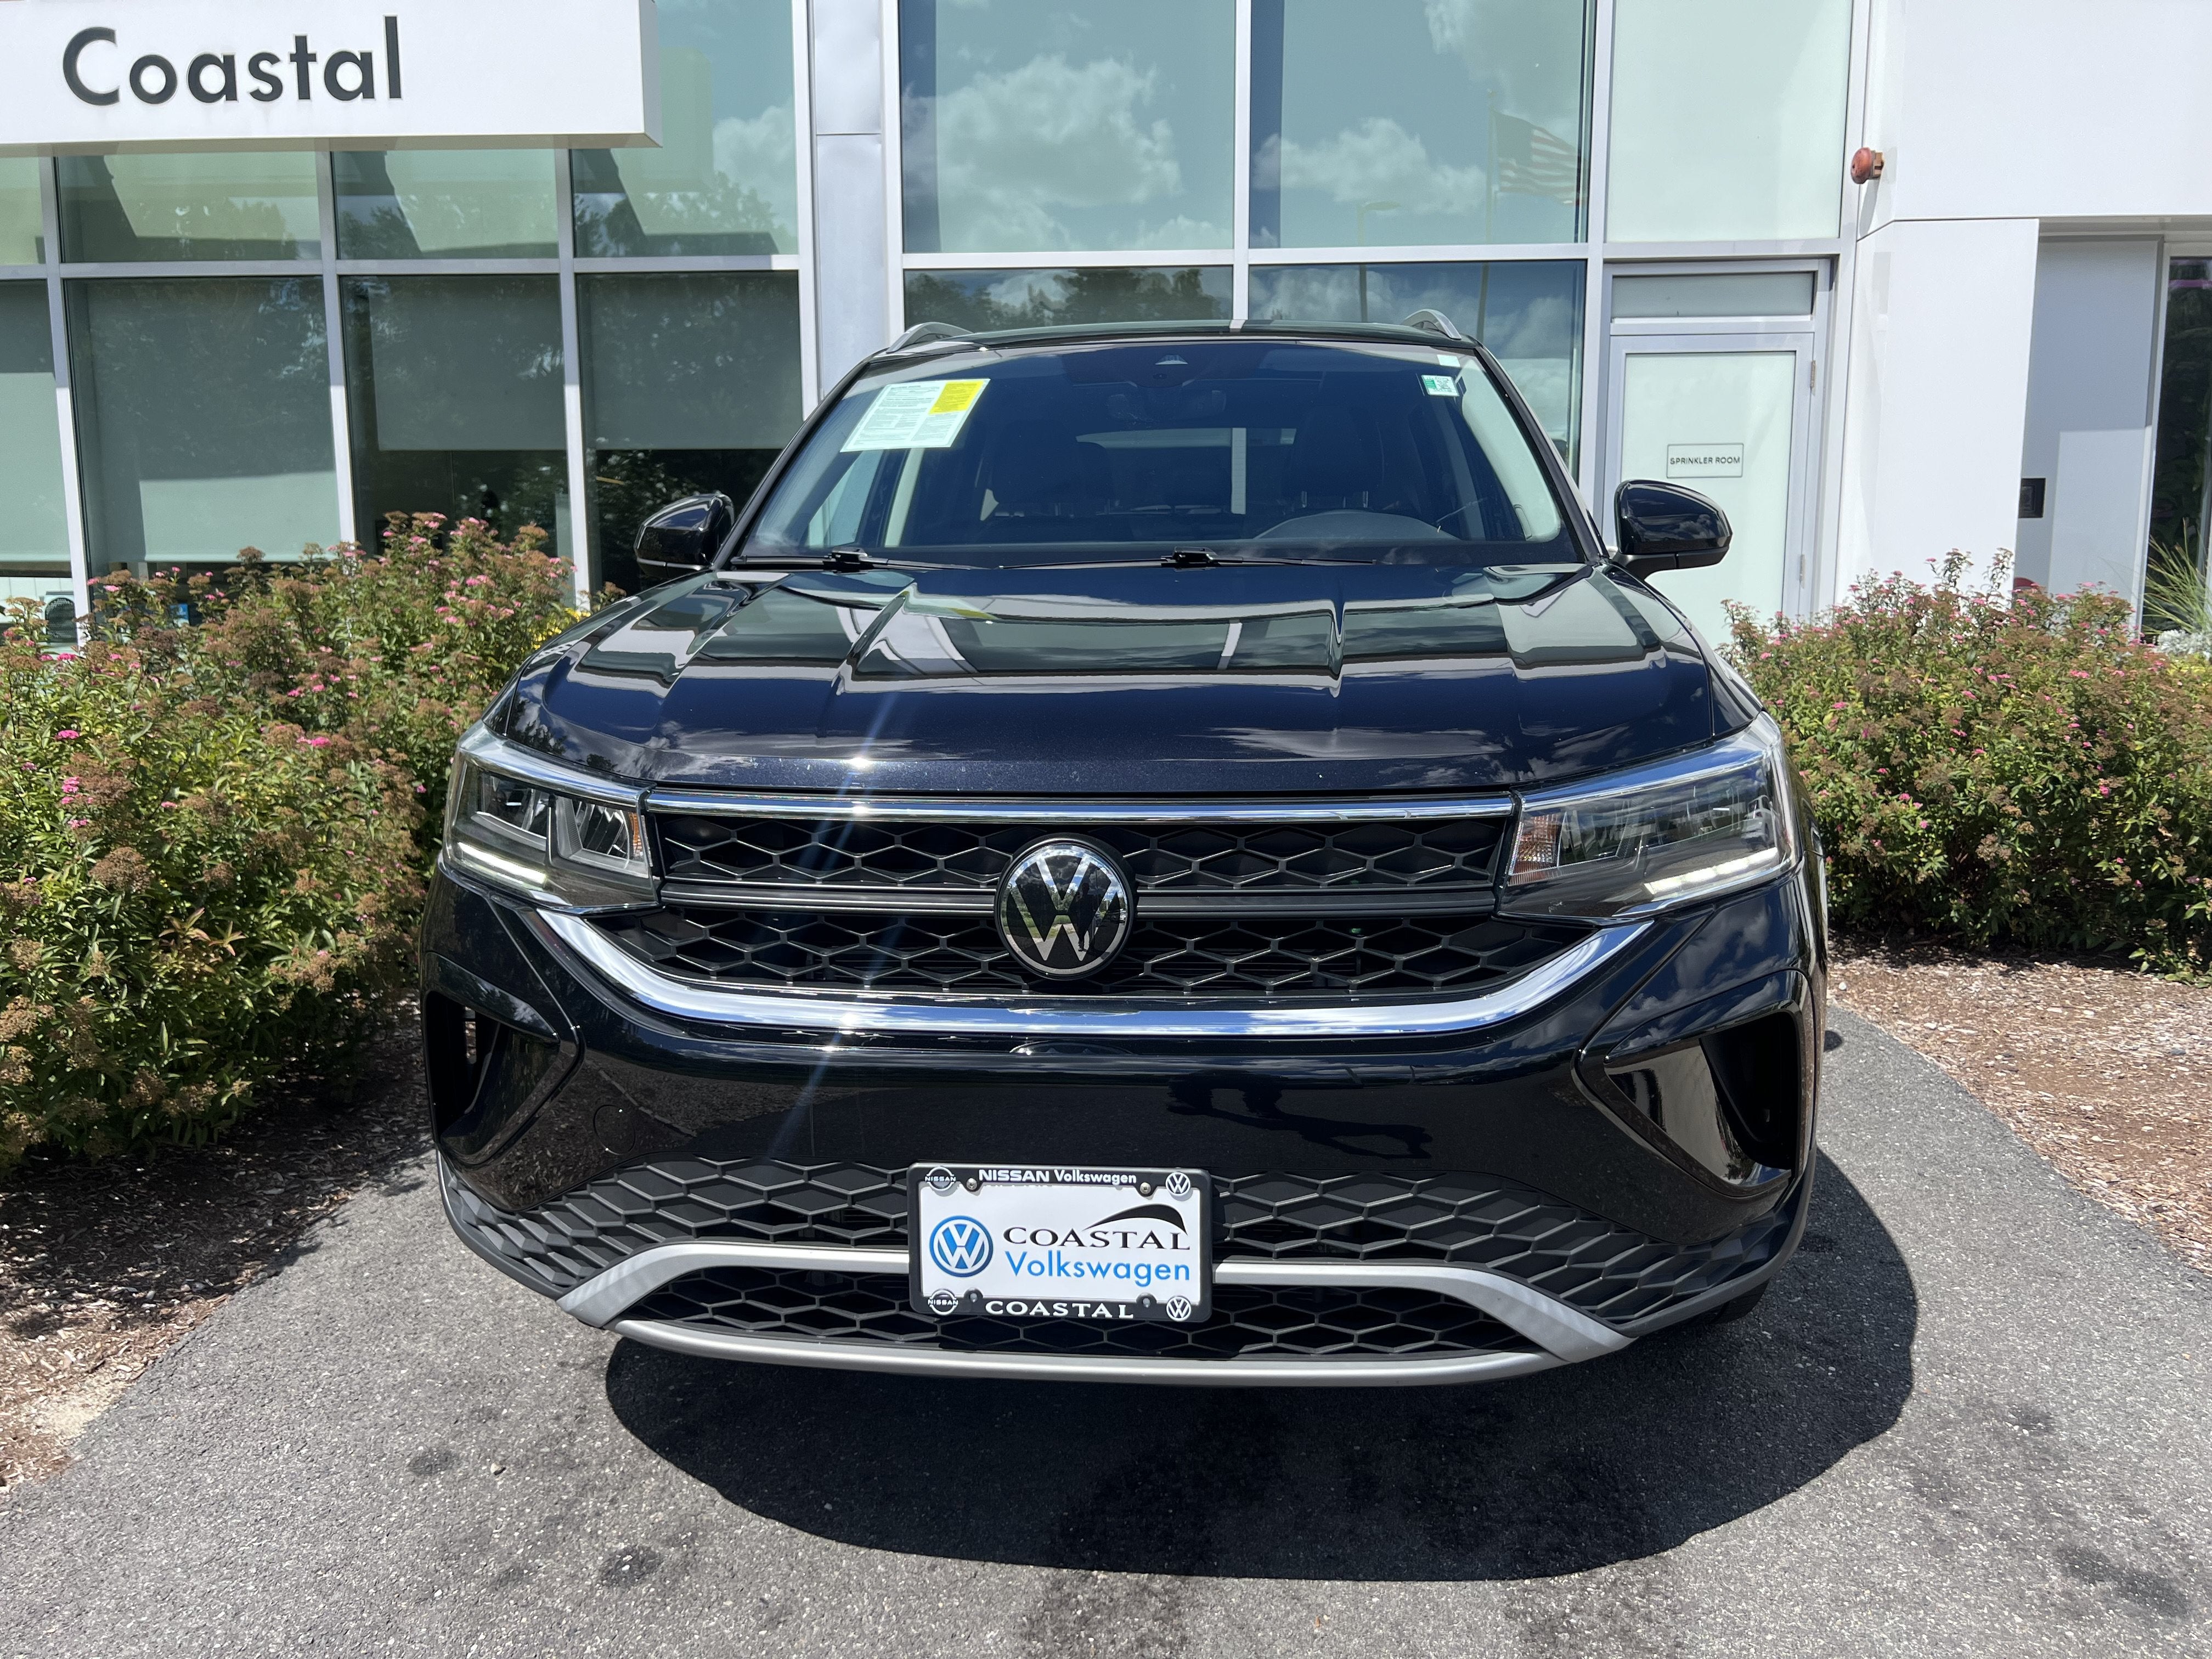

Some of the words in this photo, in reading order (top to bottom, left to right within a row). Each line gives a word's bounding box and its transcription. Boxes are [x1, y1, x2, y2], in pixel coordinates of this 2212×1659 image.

[63, 15, 402, 105] Coastal
[979, 1169, 1049, 1182] NISSAN
[1053, 1169, 1137, 1185] Volkswagen
[1003, 1227, 1190, 1250] COASTAL
[1005, 1250, 1190, 1287] Volkswagen
[985, 1301, 1134, 1319] COASTAL
